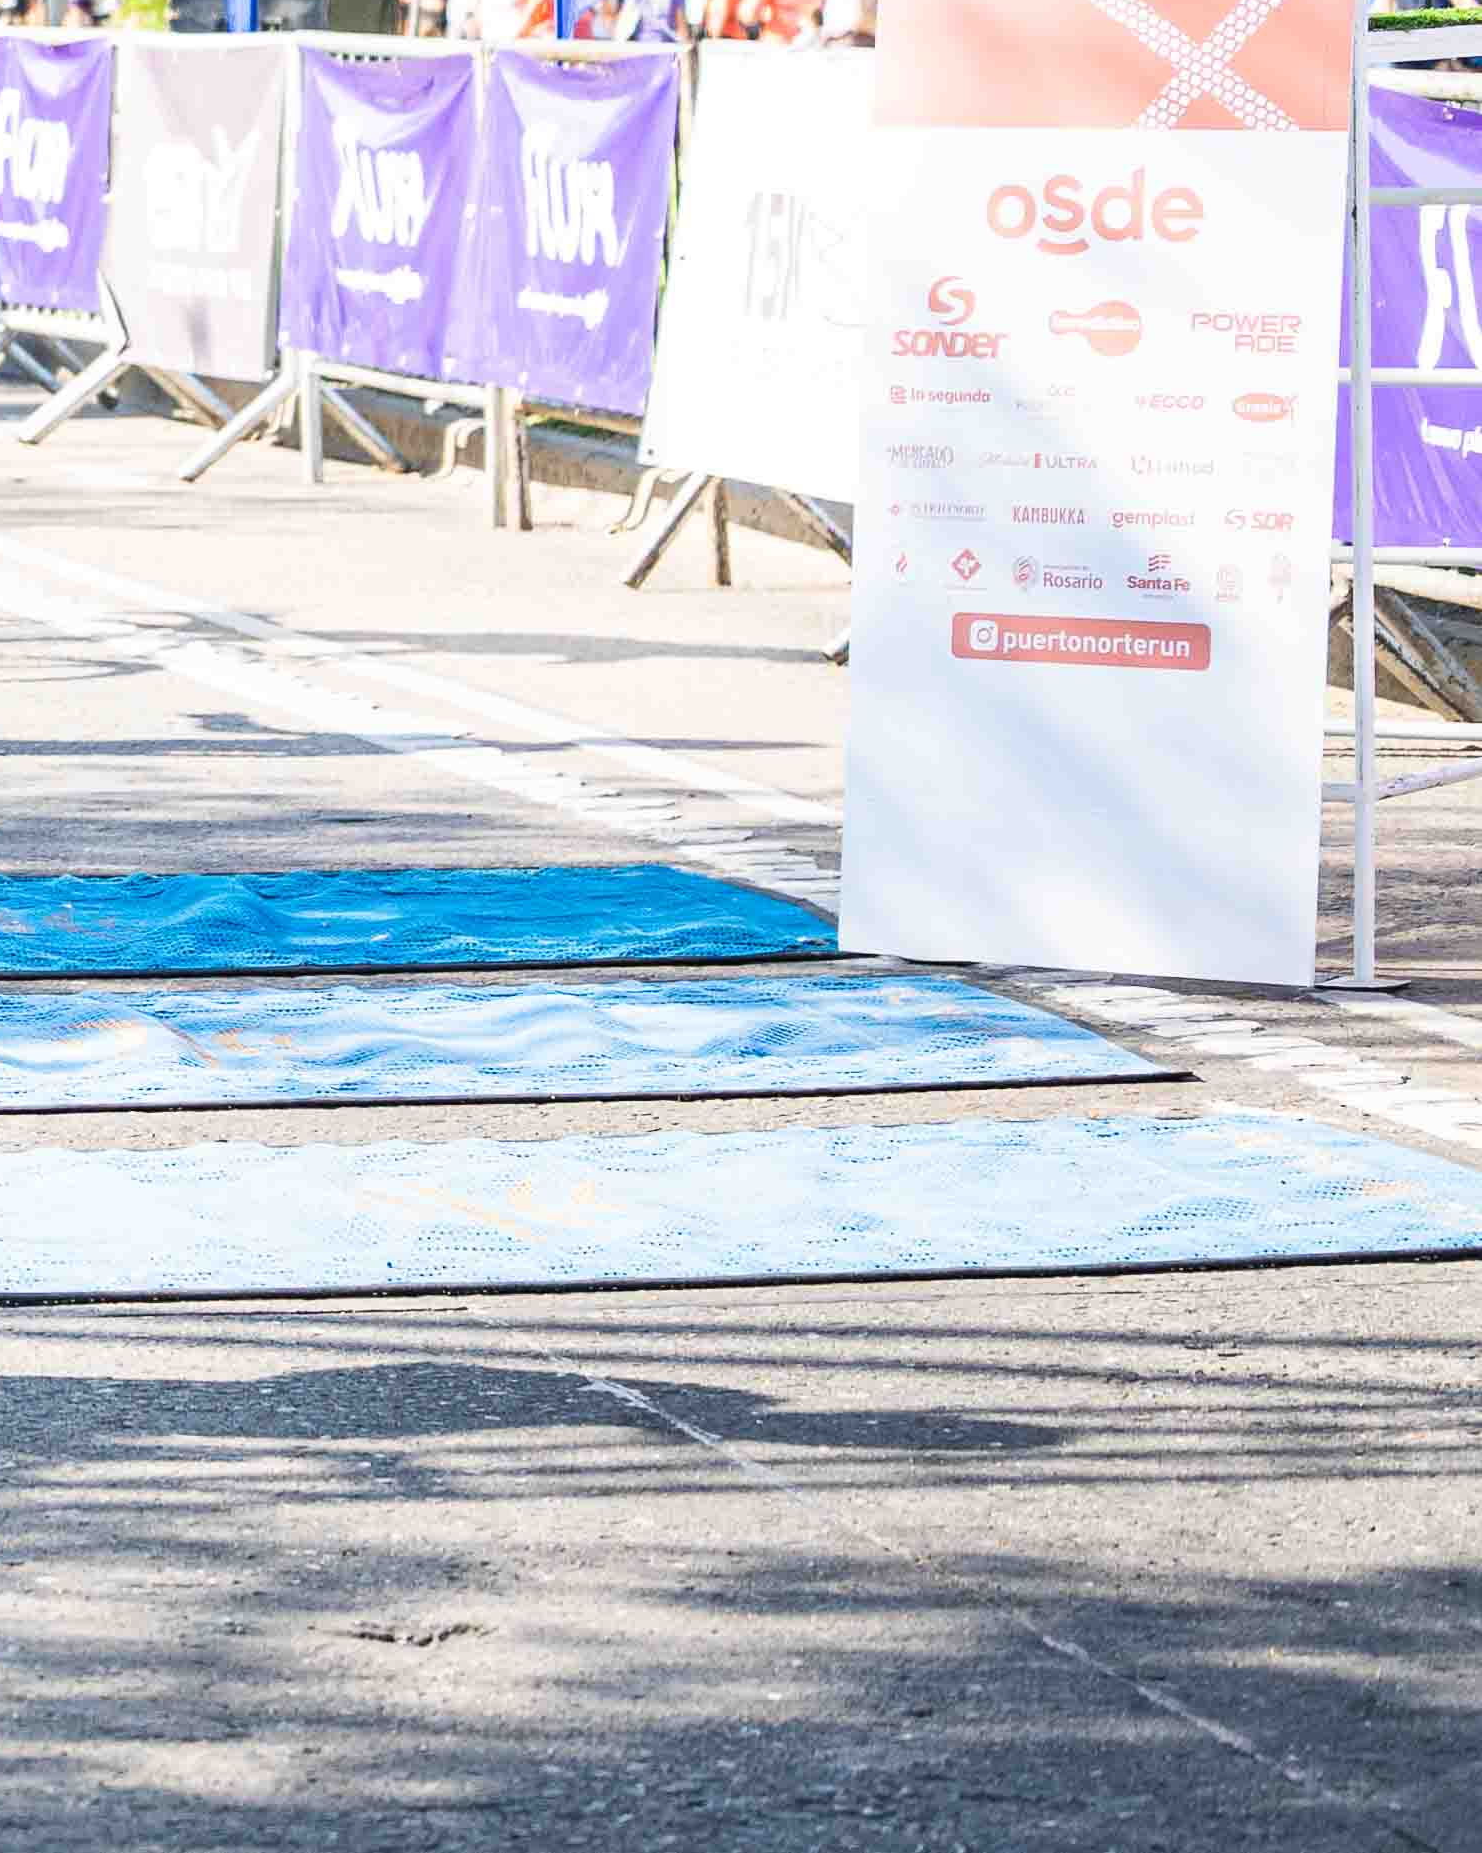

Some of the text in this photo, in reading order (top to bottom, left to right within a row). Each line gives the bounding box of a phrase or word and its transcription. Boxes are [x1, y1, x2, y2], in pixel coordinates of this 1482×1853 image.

[986, 166, 1205, 253] osde
[1192, 313, 1303, 334] POWER
[1234, 334, 1299, 353] ADE
[928, 389, 992, 405] segunda
[1045, 454, 1097, 469] ULTRA
[1012, 506, 1086, 525] KAMBUKKA
[1111, 510, 1195, 530] gemplast
[1044, 572, 1104, 589] Rosario
[1127, 576, 1191, 591] Santa Fe
[1002, 626, 1191, 662] puertonorterun
